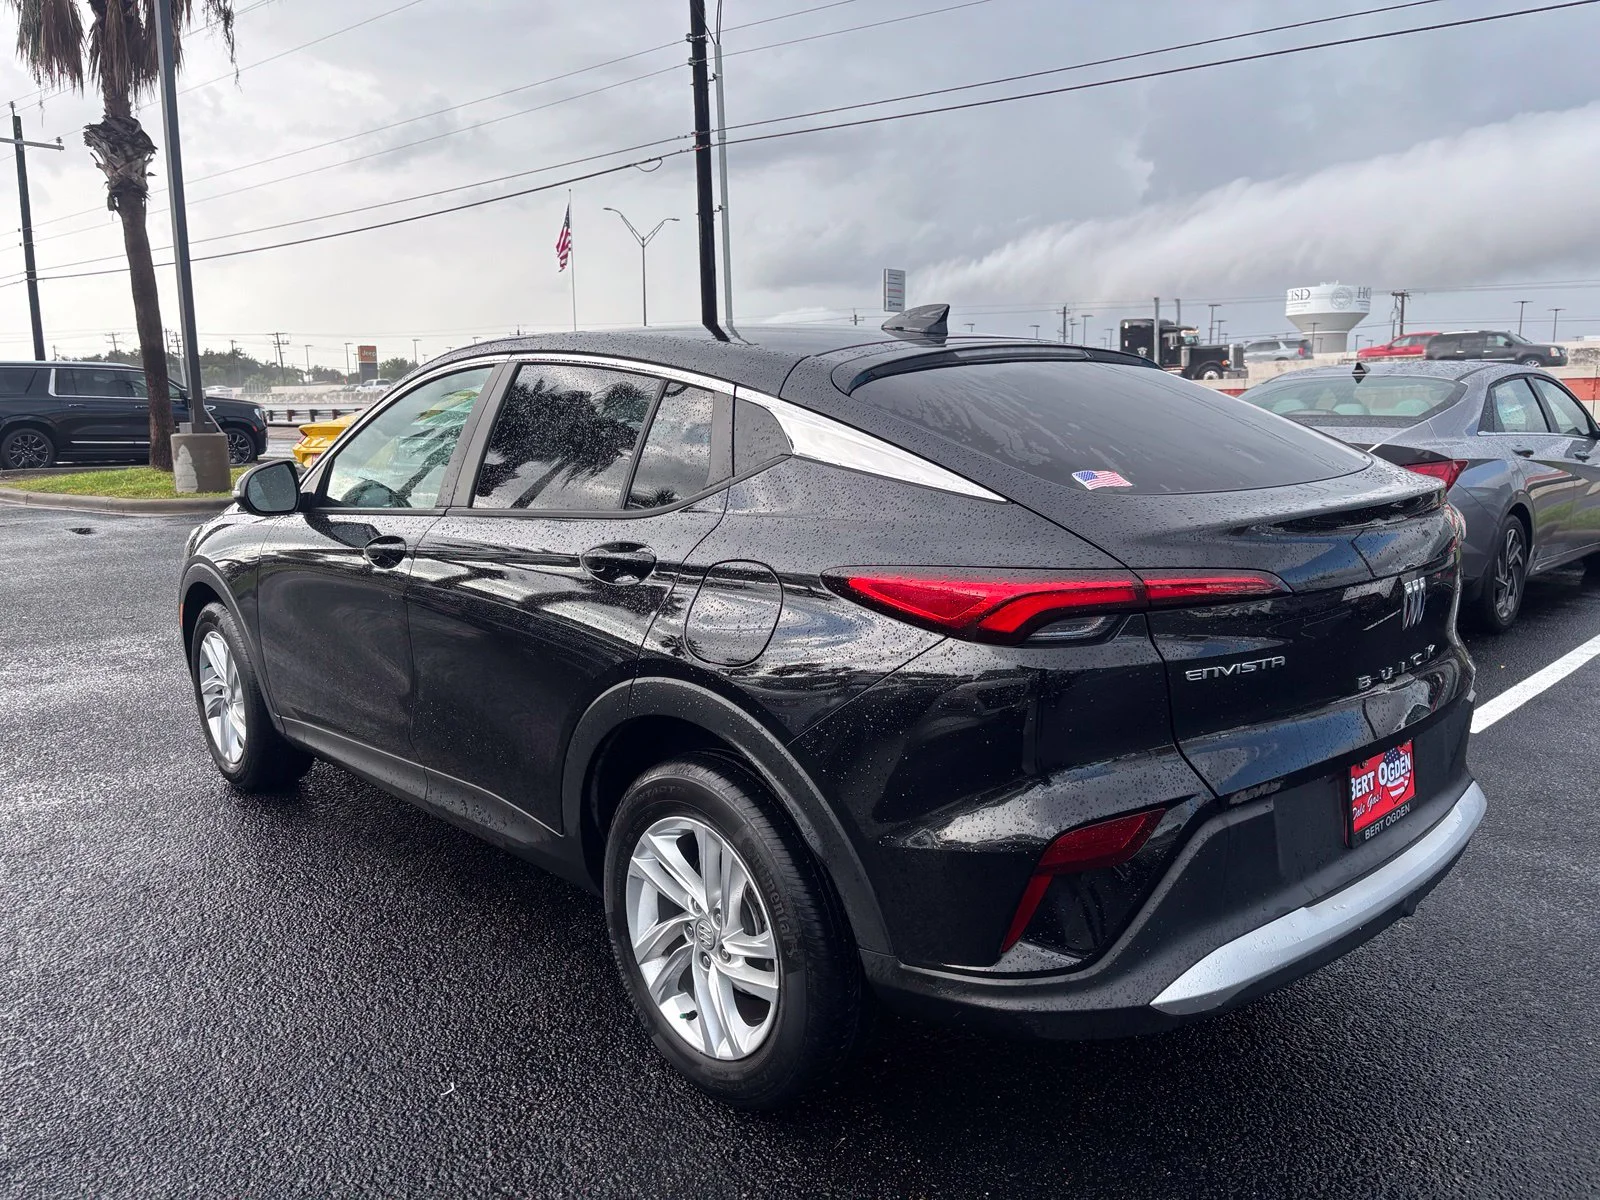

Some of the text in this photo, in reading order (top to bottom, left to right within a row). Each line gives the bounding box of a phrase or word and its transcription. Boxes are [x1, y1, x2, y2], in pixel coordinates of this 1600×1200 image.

[361, 350, 377, 358] Jeep
[1185, 656, 1286, 681] ENVISTA
[1378, 752, 1412, 786] OGDEN
[1364, 803, 1411, 840] BERT OGDEN
